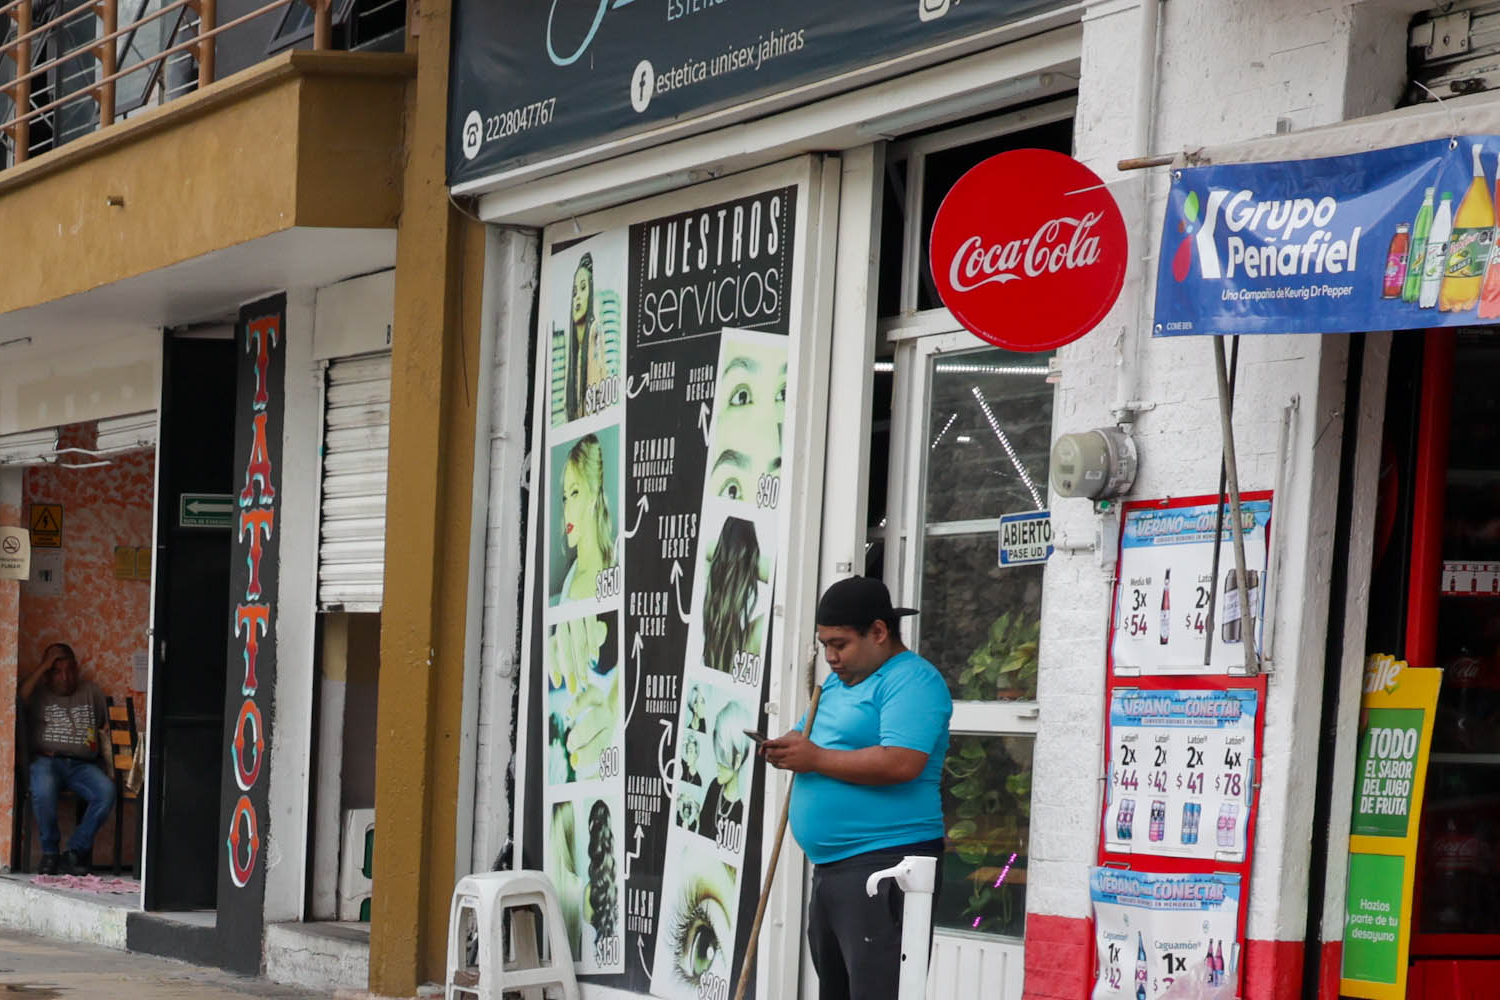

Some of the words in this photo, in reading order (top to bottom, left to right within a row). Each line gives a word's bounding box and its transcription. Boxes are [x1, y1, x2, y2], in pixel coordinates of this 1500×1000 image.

[656, 58, 707, 94] estetica
[710, 44, 754, 78] unisex
[756, 28, 805, 71] jahiras
[485, 97, 557, 142] 2228047767
[1225, 189, 1337, 240] Grupo
[648, 196, 780, 280] NUESTROS
[949, 210, 1105, 293] Coca-Cola
[1227, 226, 1362, 279] Peñafiel
[1221, 288, 1239, 301] Una
[1276, 288, 1285, 299] de
[1284, 286, 1310, 300] Keurig
[1311, 285, 1322, 297] Dr
[1321, 284, 1354, 299] Pepper
[584, 375, 620, 416] $1,200
[633, 436, 675, 462] PEINADO
[756, 473, 781, 509] $90
[658, 513, 698, 540] TINTES
[1003, 519, 1051, 546] ABIERTO
[1136, 515, 1184, 537] VERANO
[661, 537, 690, 559] DESDE
[1008, 547, 1029, 560] PASE
[1031, 546, 1045, 557] UD.
[596, 565, 621, 602] $650
[226, 314, 280, 888] TATTOO
[630, 591, 668, 616] GELISH
[1132, 588, 1147, 611] 3x
[731, 650, 762, 688] $250
[645, 674, 677, 700] CORTE
[1123, 698, 1171, 717] VERANO
[1185, 699, 1242, 718] CONECTAR
[1120, 744, 1137, 766] 2x
[1370, 727, 1418, 759] TODO
[600, 745, 620, 781] $90
[1154, 745, 1168, 767] 2x
[1186, 746, 1204, 768] 2x
[1224, 747, 1242, 770] 4x
[1365, 759, 1377, 778] EL
[1378, 760, 1413, 779] SABOR
[1362, 778, 1381, 796] DEL
[1382, 779, 1410, 797] JUGO
[1360, 796, 1375, 814] DE
[1375, 797, 1408, 816] FRUTA
[716, 819, 744, 854] $100
[628, 888, 655, 918] LASH
[1153, 882, 1226, 901] CONECTAR
[1360, 898, 1390, 912] Hazlos
[1350, 913, 1374, 926] parte
[1375, 914, 1387, 926] de
[1388, 916, 1398, 927] tu
[1351, 928, 1395, 943] desayuno
[597, 936, 620, 968] $150
[1108, 942, 1121, 965] 1x
[1162, 952, 1187, 974] 1x
